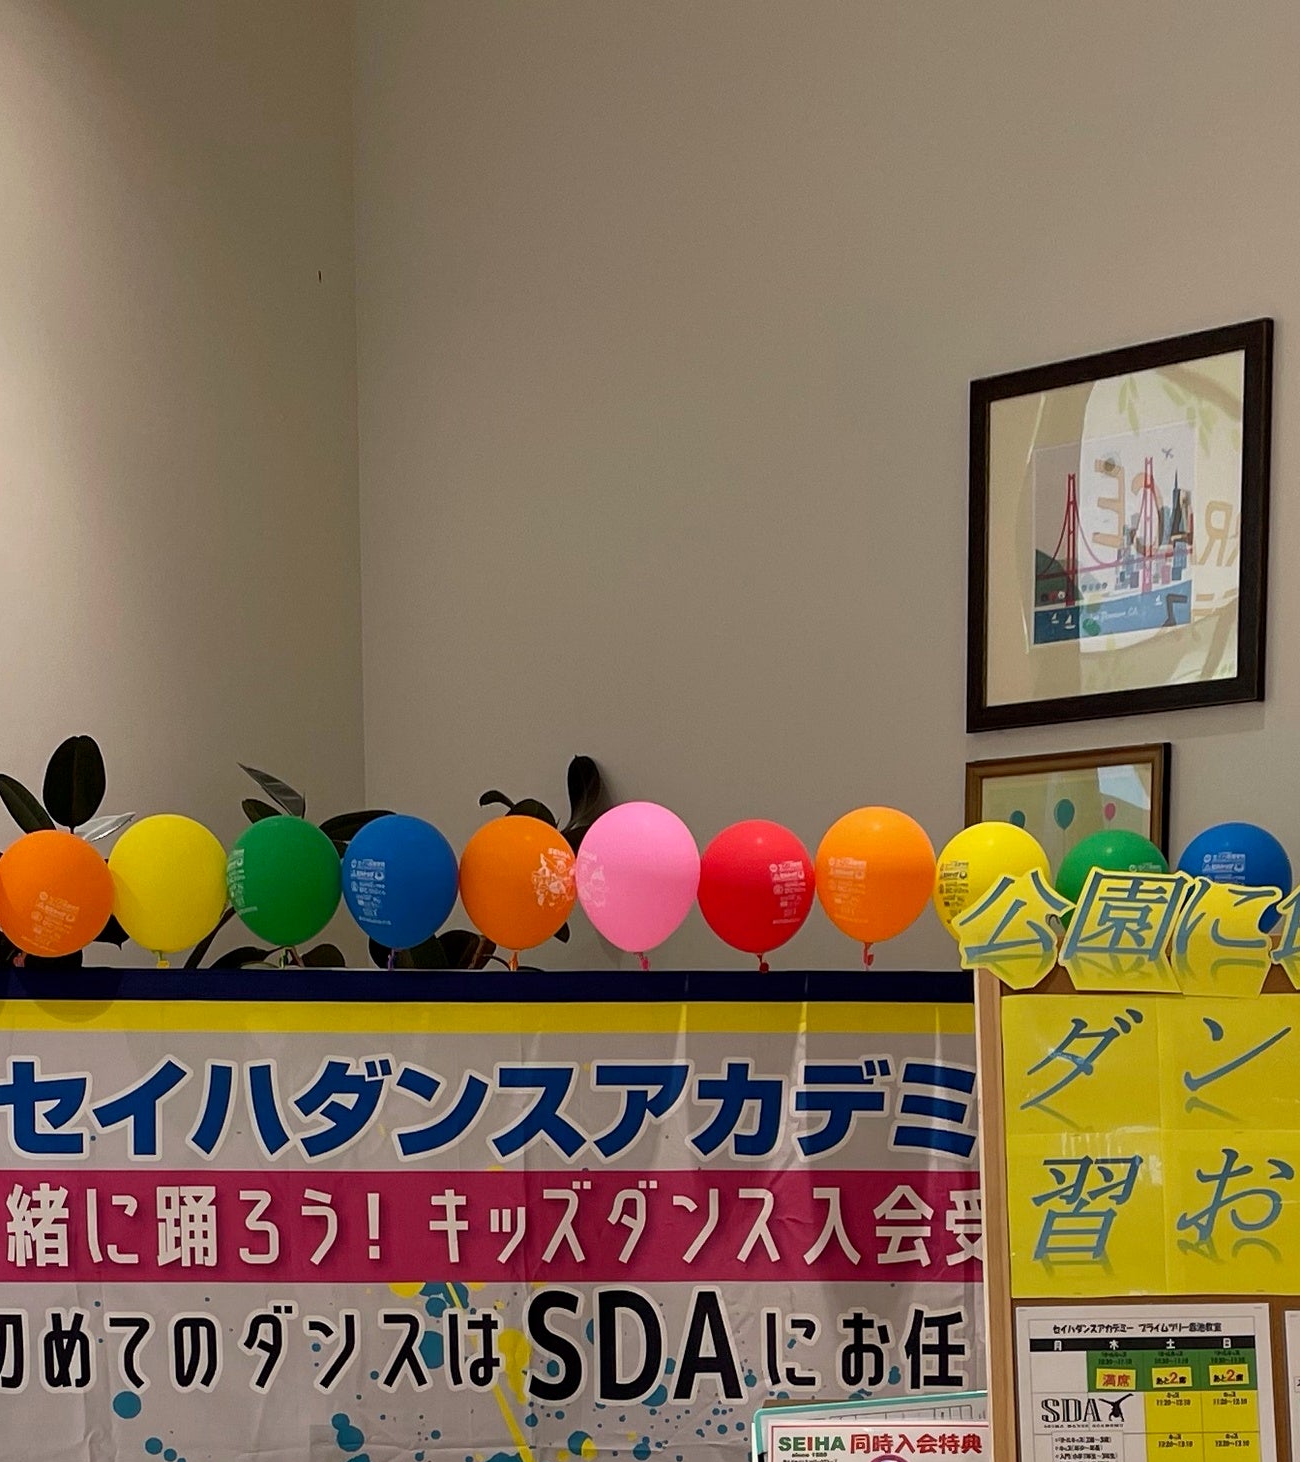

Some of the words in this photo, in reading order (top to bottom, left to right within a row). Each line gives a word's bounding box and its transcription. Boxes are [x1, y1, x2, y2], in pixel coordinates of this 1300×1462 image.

[1041, 1398, 1101, 1422] SDA
[778, 1436, 846, 1452] SEIHA
[850, 1433, 983, 1455] 同時入会特典
